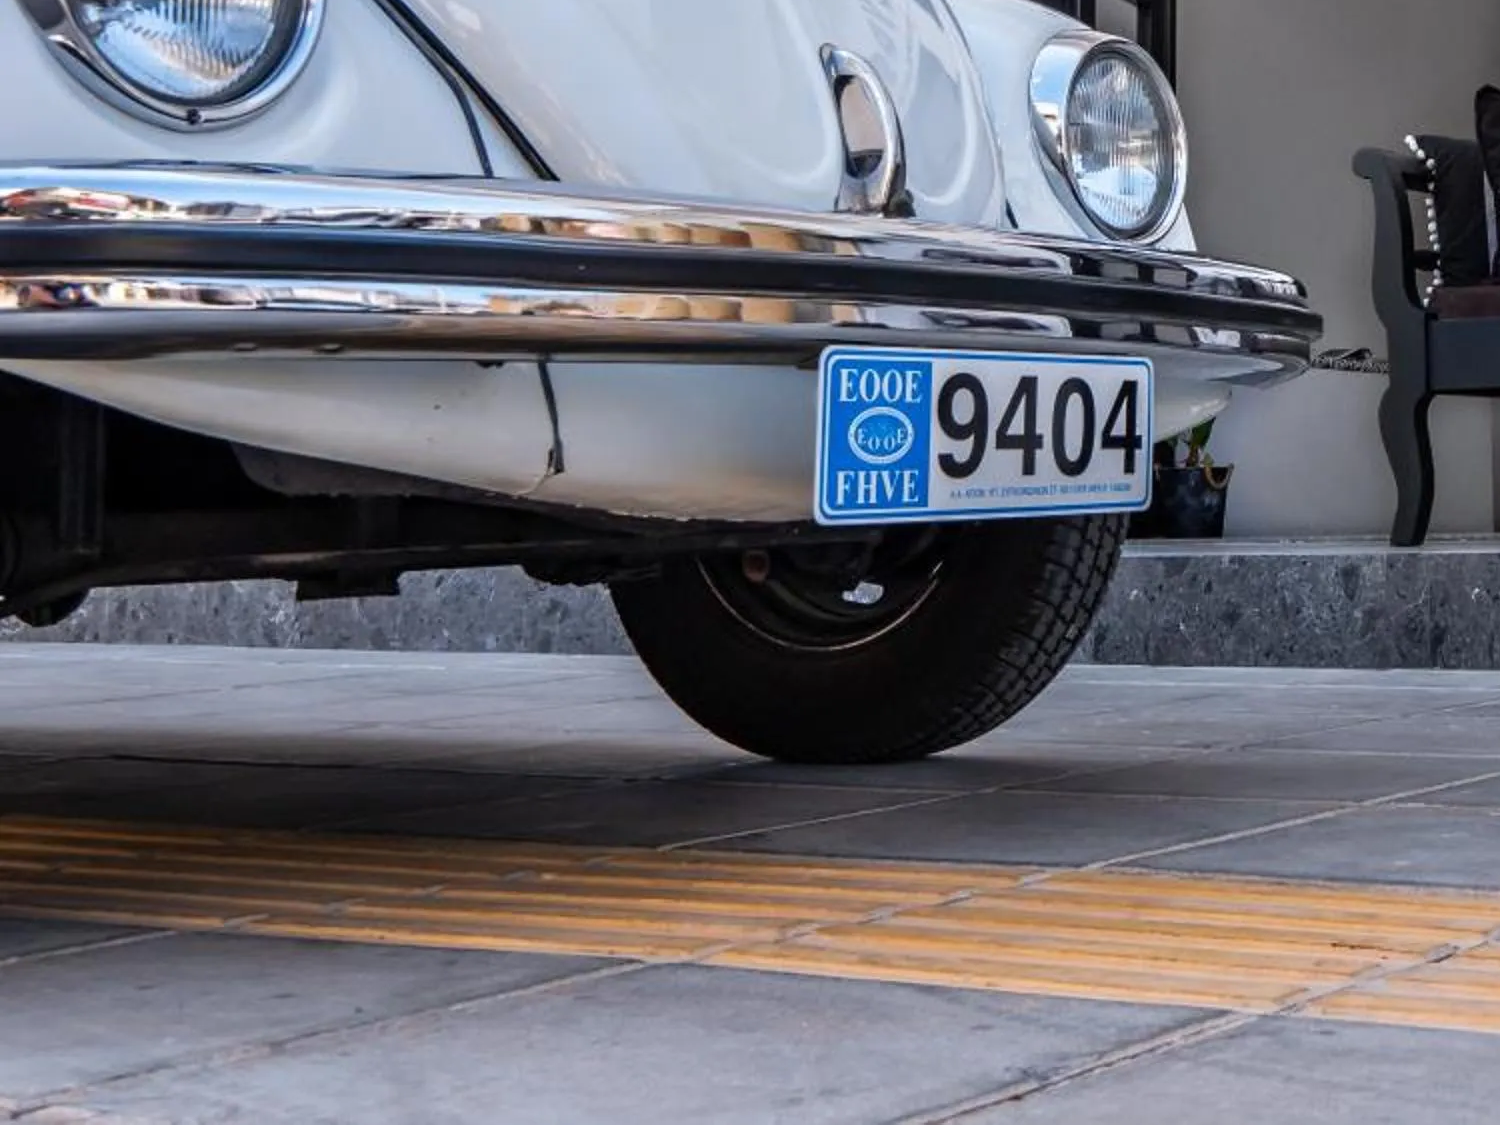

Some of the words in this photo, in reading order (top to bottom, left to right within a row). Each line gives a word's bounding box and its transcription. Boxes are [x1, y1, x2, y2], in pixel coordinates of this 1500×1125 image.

[838, 368, 922, 404] EOOE
[937, 372, 1143, 479] 9404
[835, 470, 920, 506] FHVE
